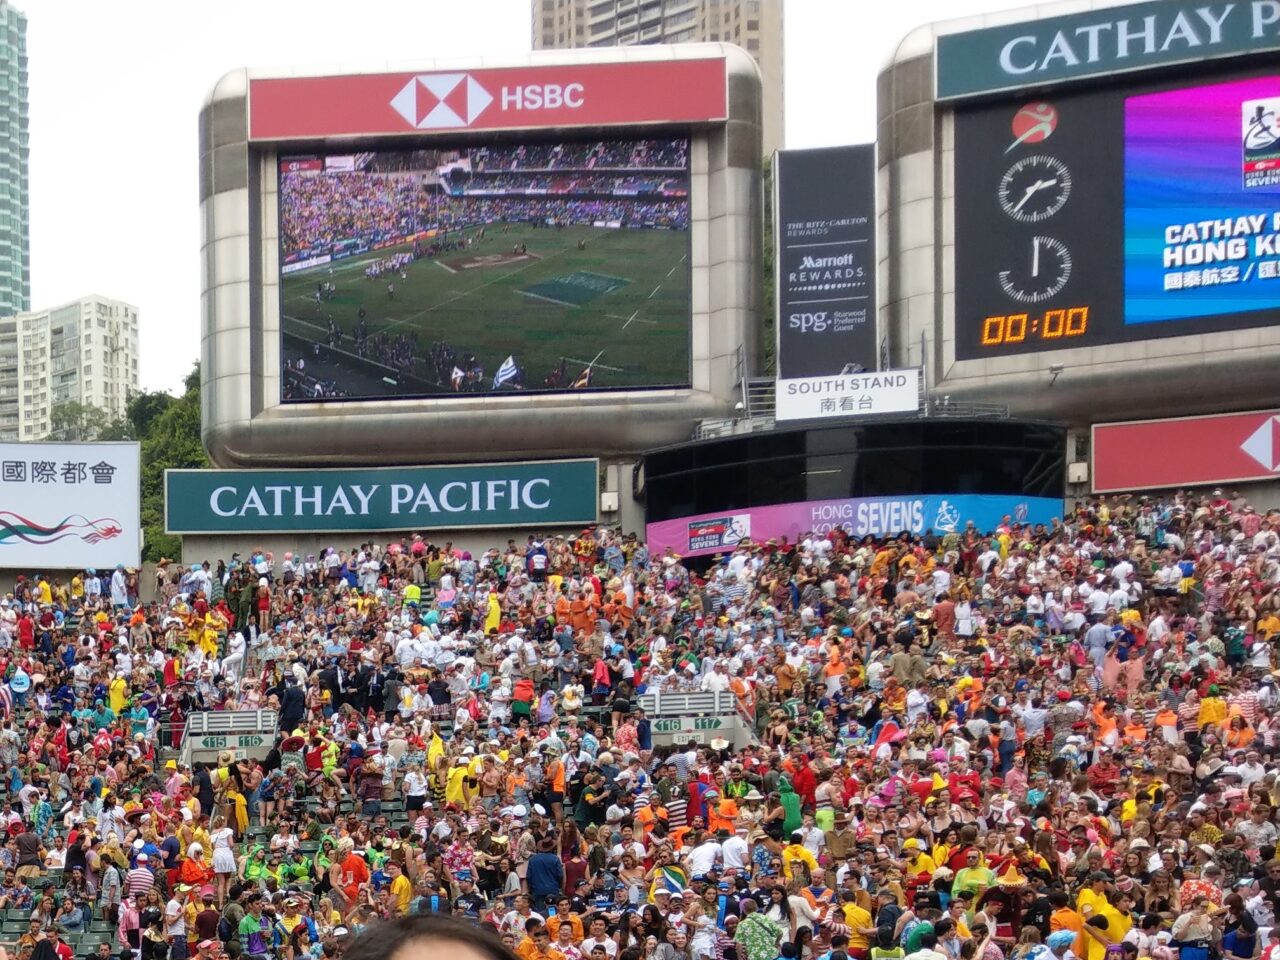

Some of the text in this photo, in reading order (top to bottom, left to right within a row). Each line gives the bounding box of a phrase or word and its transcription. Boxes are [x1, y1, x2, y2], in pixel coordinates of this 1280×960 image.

[999, 4, 1236, 75] CATHAY
[501, 83, 585, 111] HSBC
[787, 227, 829, 237] REWARDS
[806, 217, 868, 229] RITZ-CARLTON
[1165, 213, 1266, 244] CATHAY
[799, 253, 854, 270] Marriott
[1163, 239, 1248, 269] HONG
[982, 306, 1089, 346] 00:00
[787, 375, 907, 395] SOUTH STAND
[820, 394, 873, 413] 南看台
[209, 478, 551, 517] CATHAY PACIFIC
[812, 504, 853, 520] HONG
[857, 500, 923, 534] SEVENS
[691, 540, 719, 550] SEVENS
[659, 718, 717, 731] 116 117
[206, 736, 260, 748] 115 116
